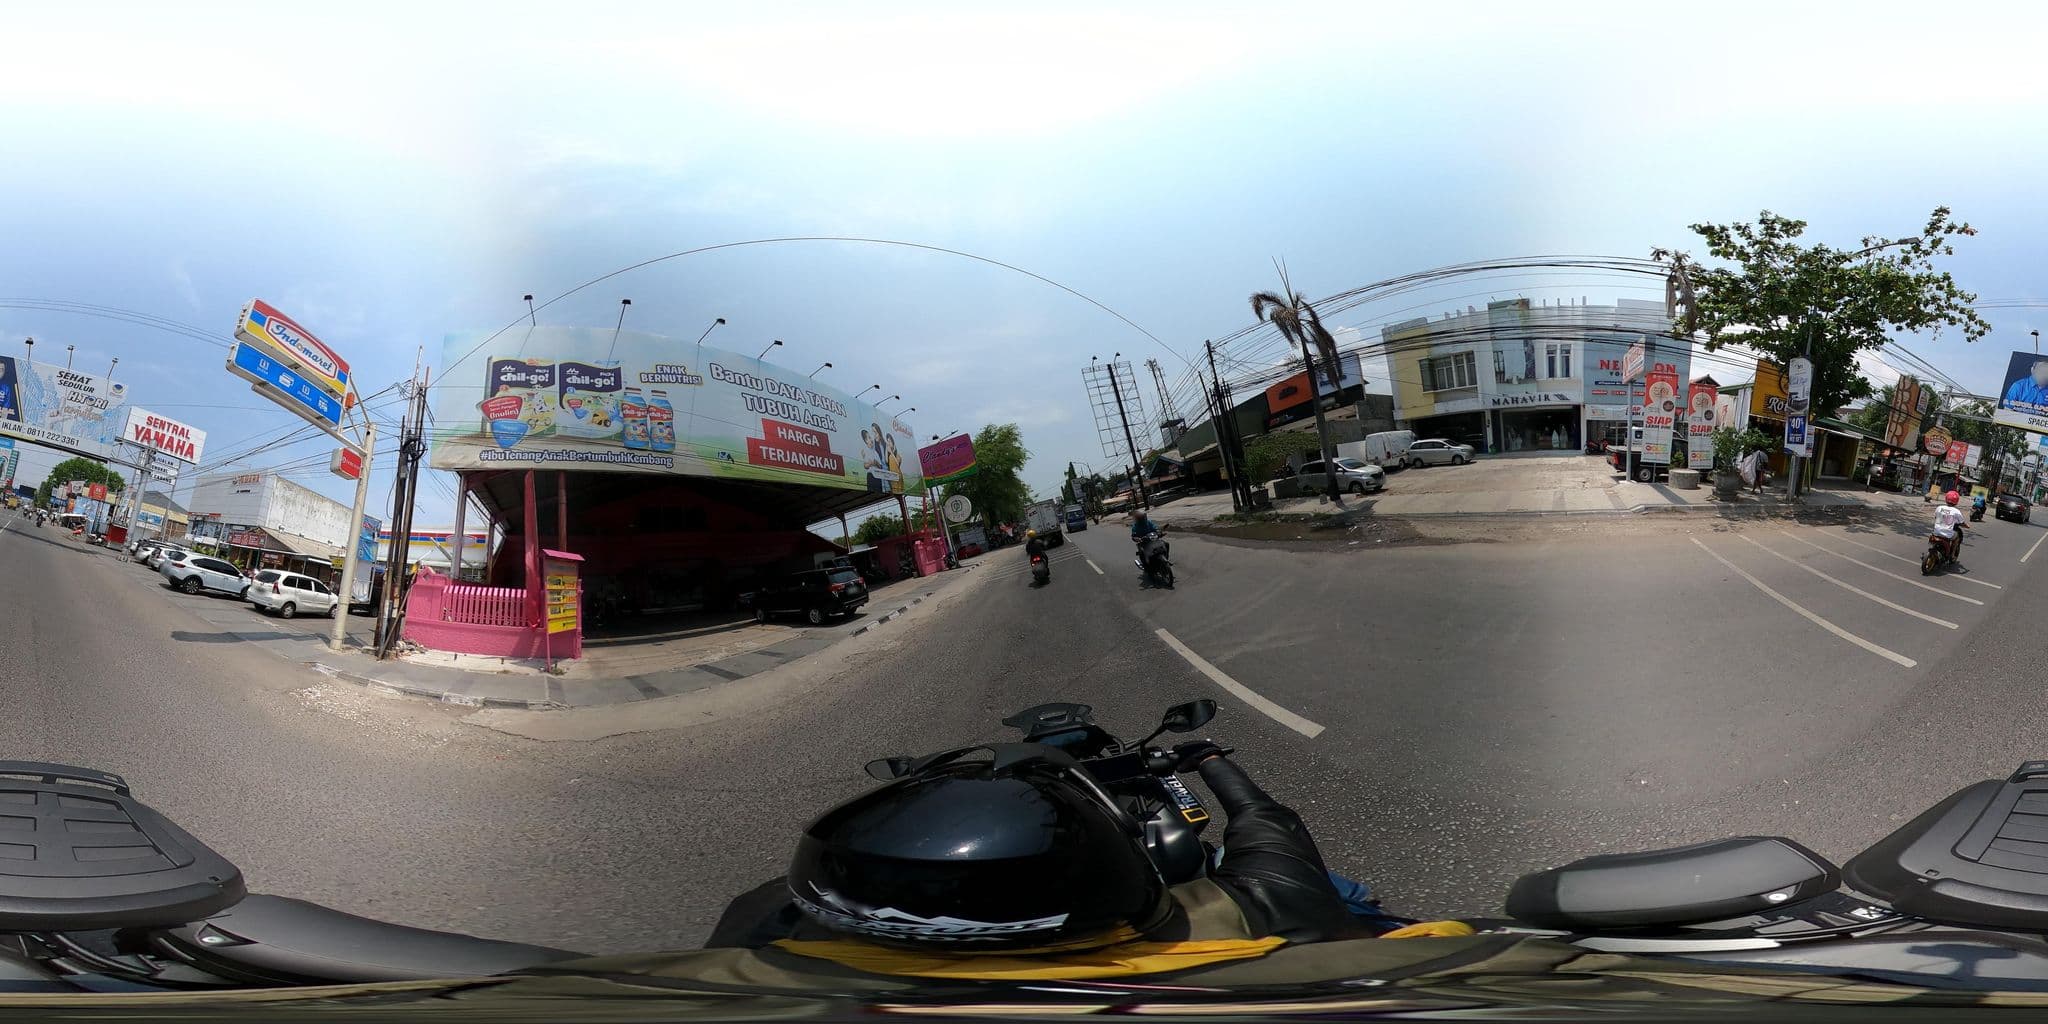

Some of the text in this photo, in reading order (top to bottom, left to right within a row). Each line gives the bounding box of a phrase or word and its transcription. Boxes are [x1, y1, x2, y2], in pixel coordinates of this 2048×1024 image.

[270, 323, 333, 372] Indomaret
[56, 370, 93, 385] SEHAT
[656, 365, 686, 375] ENAK
[57, 379, 95, 393] SEDULUR
[709, 362, 847, 418] Bantu DAYA TAHAN
[1491, 393, 1551, 406] MAHAVIR
[741, 392, 837, 432] TUBUH Anak
[1646, 415, 1672, 425] SIAP
[26, 427, 45, 438] 0811
[46, 431, 62, 442] 222
[61, 435, 80, 447] 3361
[146, 415, 191, 440] SENTRAL
[777, 426, 820, 447] HARGA
[134, 424, 196, 460] YAMAHA
[480, 449, 674, 467] #IbuTenangAnakBertumbuhKembang
[760, 446, 838, 471] TERJANGKAU
